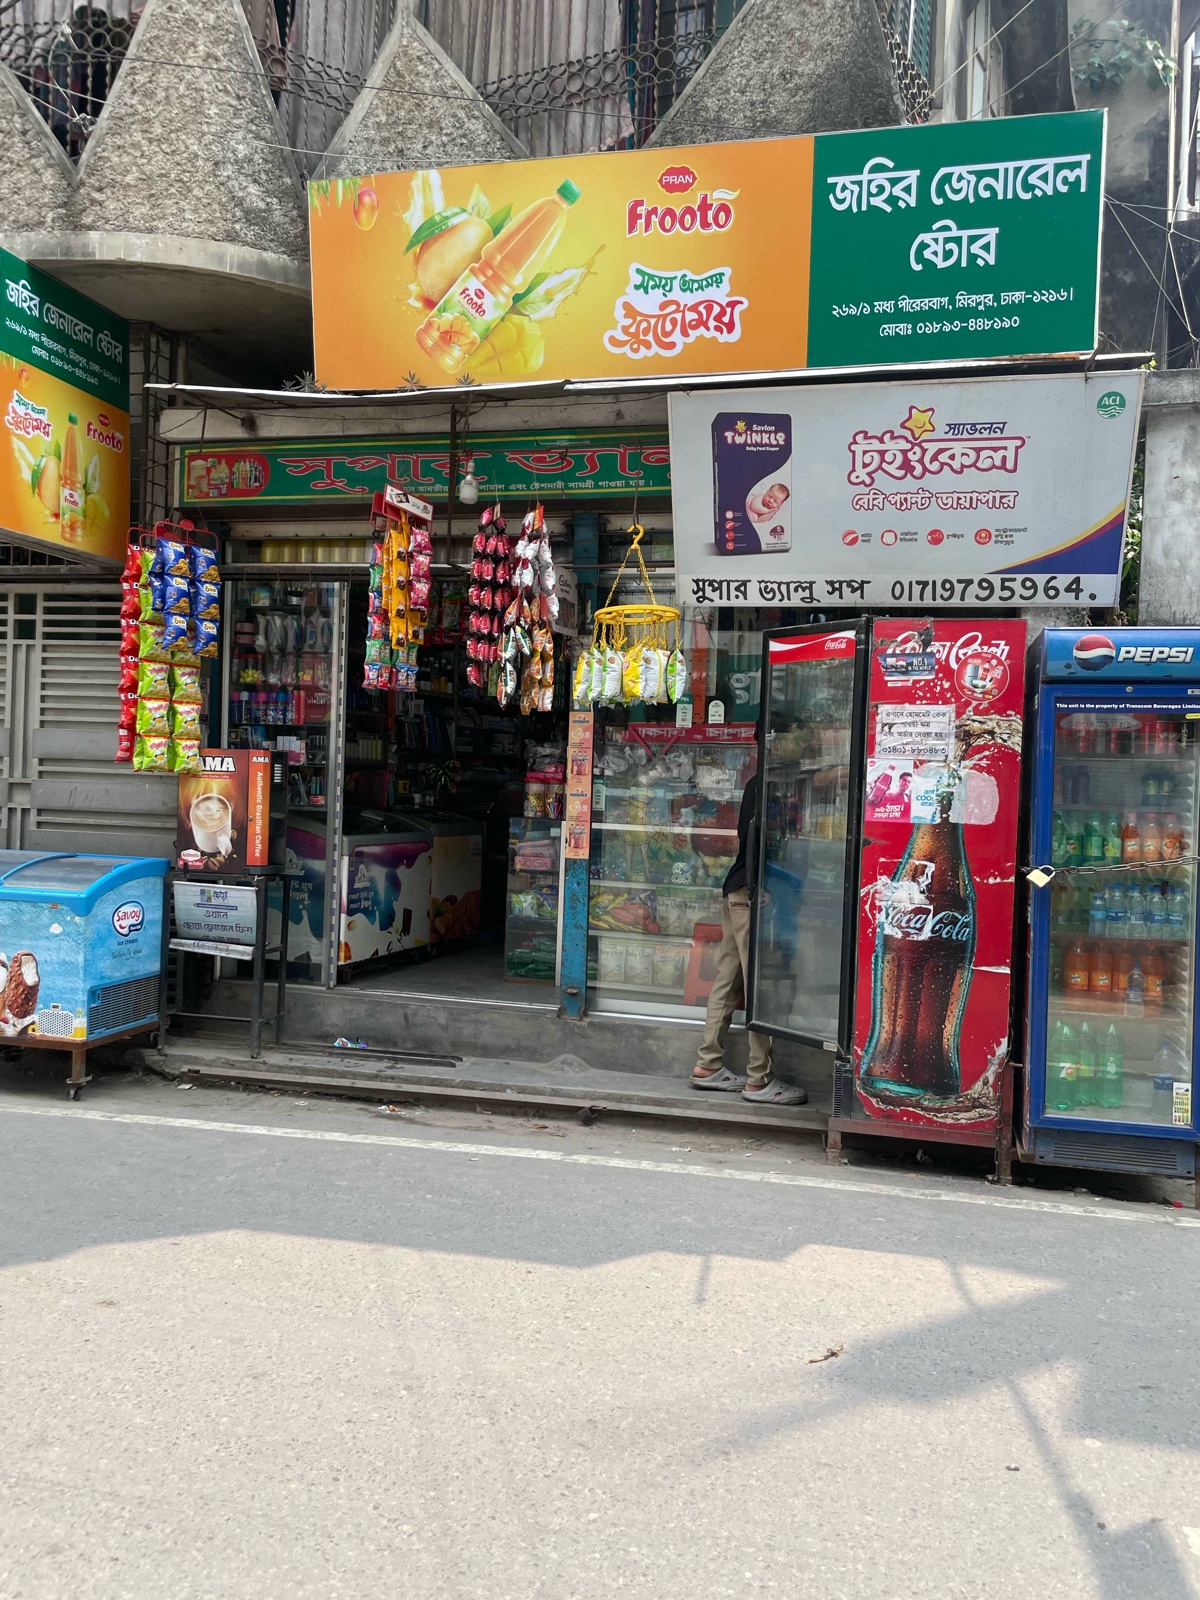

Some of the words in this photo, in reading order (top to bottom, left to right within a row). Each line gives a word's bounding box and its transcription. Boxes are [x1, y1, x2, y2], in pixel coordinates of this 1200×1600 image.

[663, 175, 693, 185] PRAN
[827, 157, 920, 213] জহির
[931, 154, 1091, 205] জেনারেল
[627, 194, 733, 236] Frooto
[910, 219, 999, 271] ষ্টোর
[634, 268, 677, 297] সময়
[679, 272, 725, 294] অসময়
[459, 287, 486, 317] Frooto
[832, 303, 870, 317] ২৬৯/১
[874, 299, 894, 314] মধ্য
[898, 296, 952, 312] পীরেরবাগ,
[955, 291, 997, 312] মিরপুর,
[5, 279, 40, 318] জহির
[43, 303, 94, 348] জেনারেল
[96, 330, 123, 364] ষ্টোর
[879, 323, 912, 337] মোবাঃ
[917, 317, 1019, 335] ০১৮৯৩-৪৪৮১৯০
[1100, 396, 1120, 406] ACI
[87, 421, 123, 452] Frooto
[944, 421, 1007, 437] স্যাভলন
[598, 480, 625, 488] পাওয়া
[852, 488, 885, 511] বেবি
[887, 487, 932, 511] প্যান্ট
[935, 490, 1019, 510] ডায়াপার
[691, 577, 751, 604] সুপার
[757, 578, 821, 604] ভ্যালু
[825, 578, 872, 600] সপ
[890, 576, 1098, 602] 01719795964.
[1117, 645, 1194, 663] PEPSI
[254, 836, 262, 857] Coffee
[116, 909, 142, 922] Savoy
[204, 911, 228, 920] এখানে
